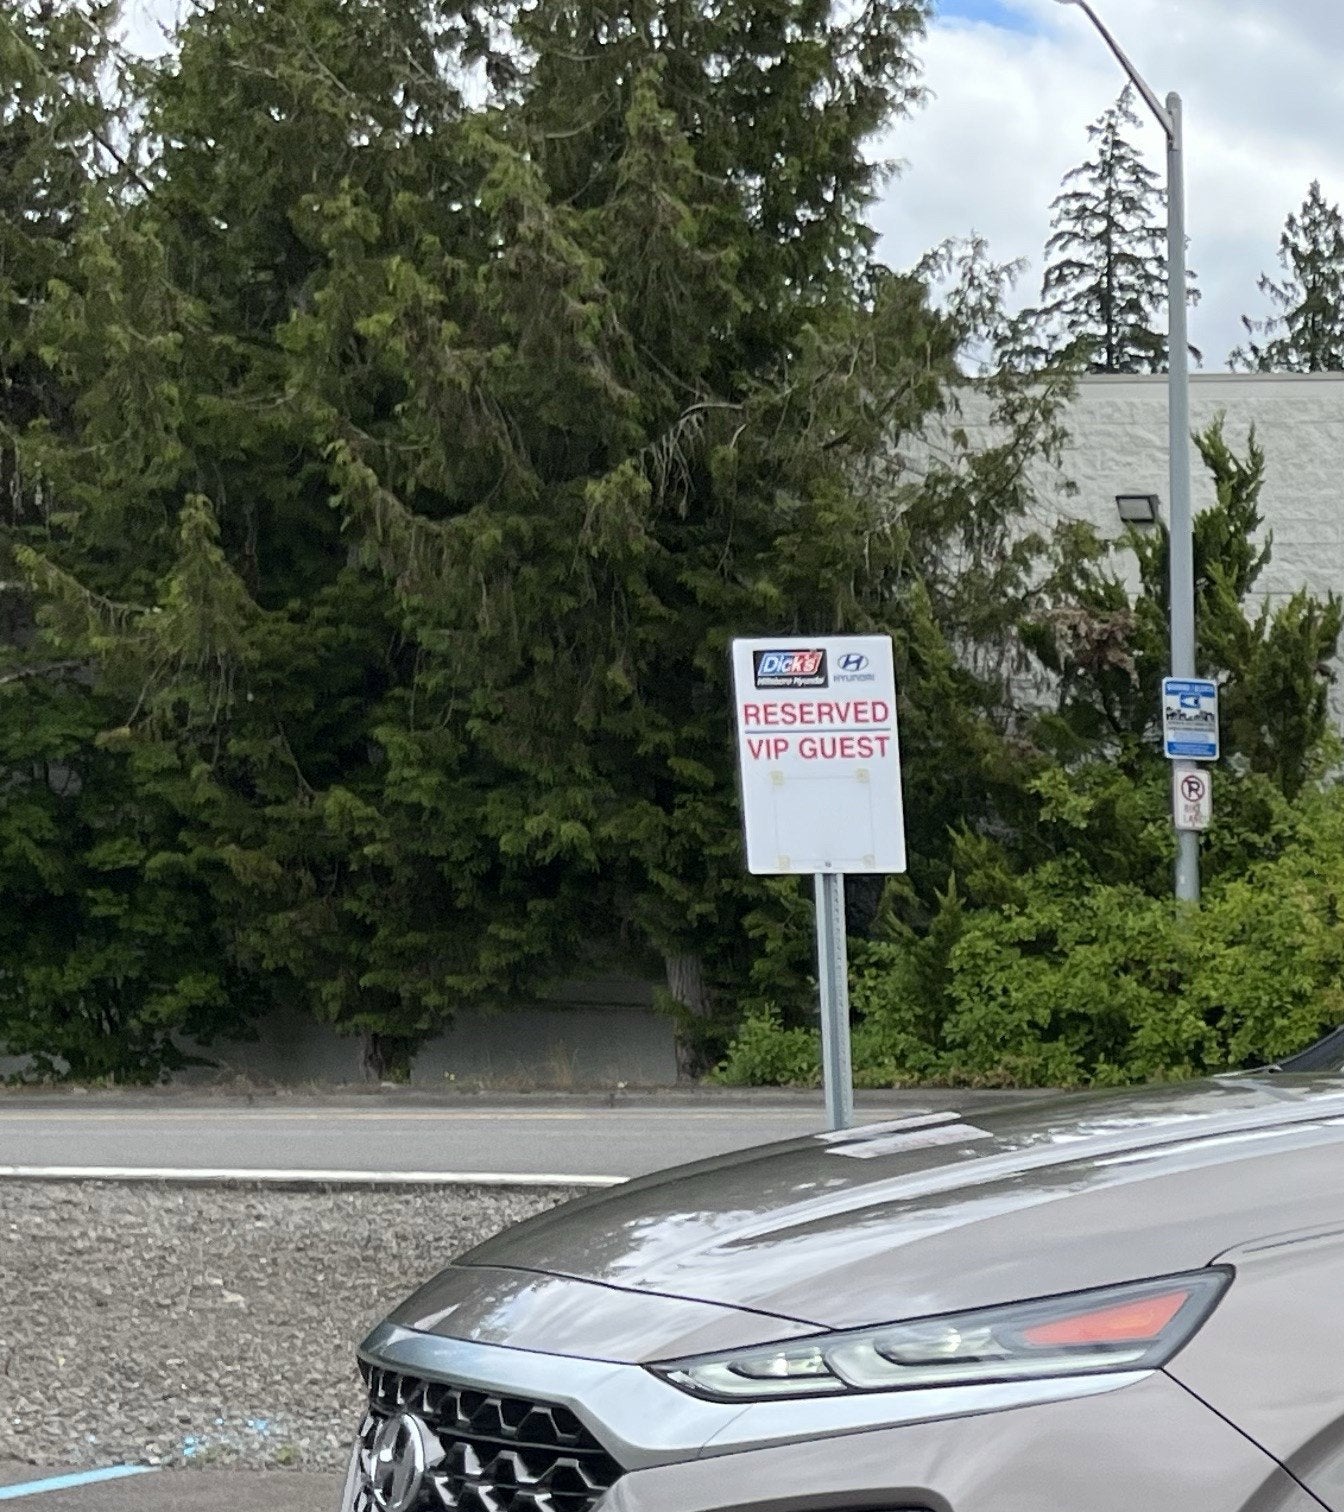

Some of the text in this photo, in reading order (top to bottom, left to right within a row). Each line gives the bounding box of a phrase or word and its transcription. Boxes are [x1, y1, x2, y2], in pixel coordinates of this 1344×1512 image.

[743, 701, 889, 726] RESERVED
[747, 736, 890, 760] VIP GUEST
